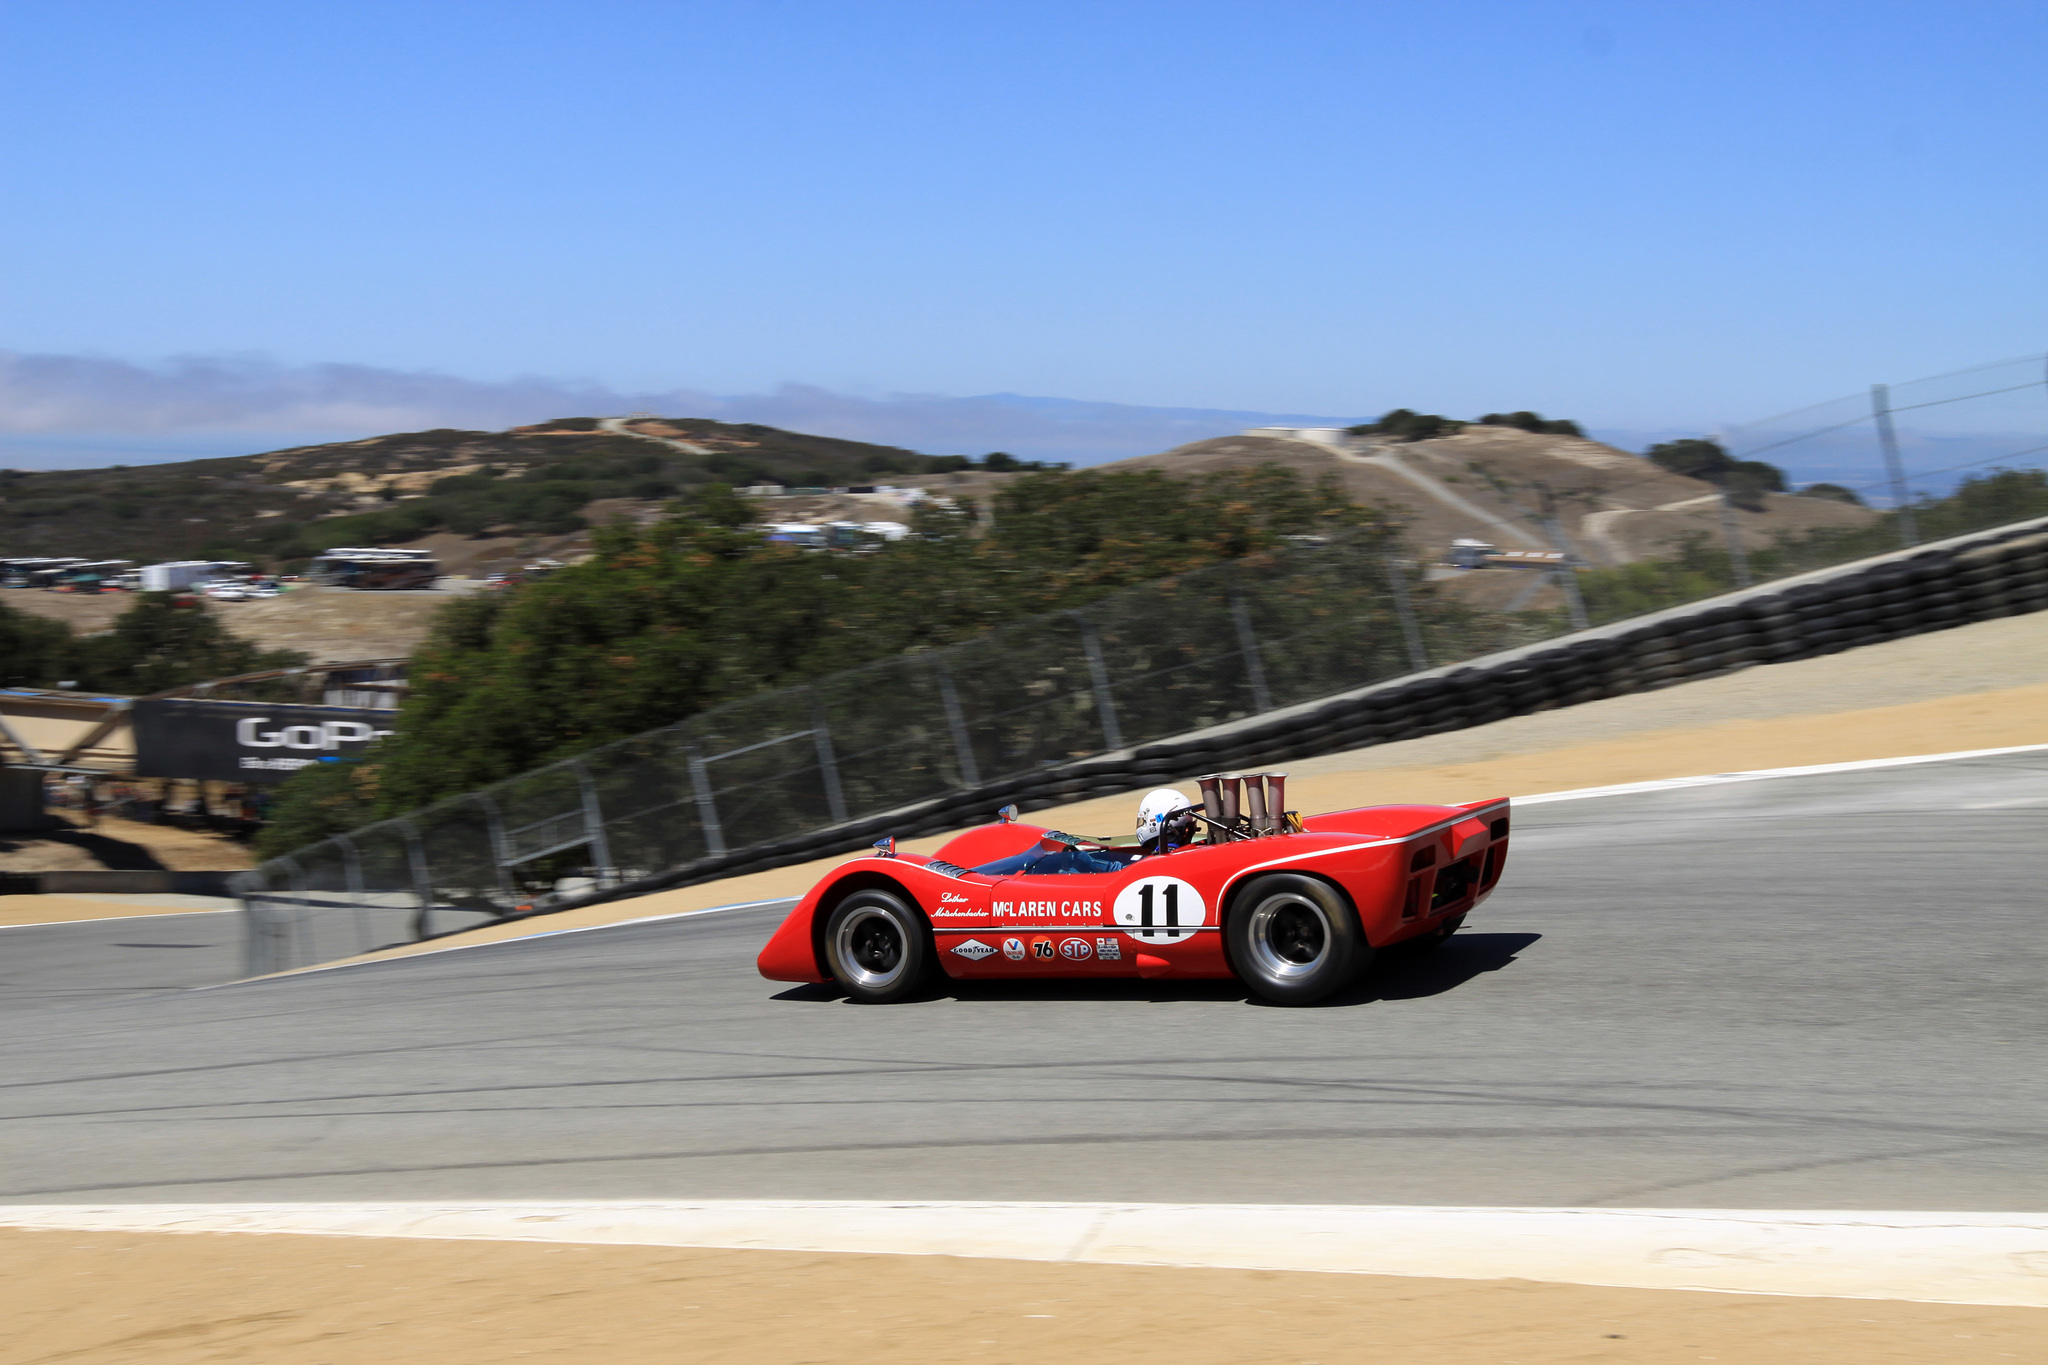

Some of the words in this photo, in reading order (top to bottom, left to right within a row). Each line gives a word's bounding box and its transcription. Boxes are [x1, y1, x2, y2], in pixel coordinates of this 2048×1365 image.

[941, 892, 969, 903] Lothar
[992, 901, 1057, 917] McLAREN
[1061, 901, 1102, 917] CARS
[1138, 884, 1180, 937] 11
[1033, 940, 1055, 958] 76
[1063, 940, 1091, 957] STP
